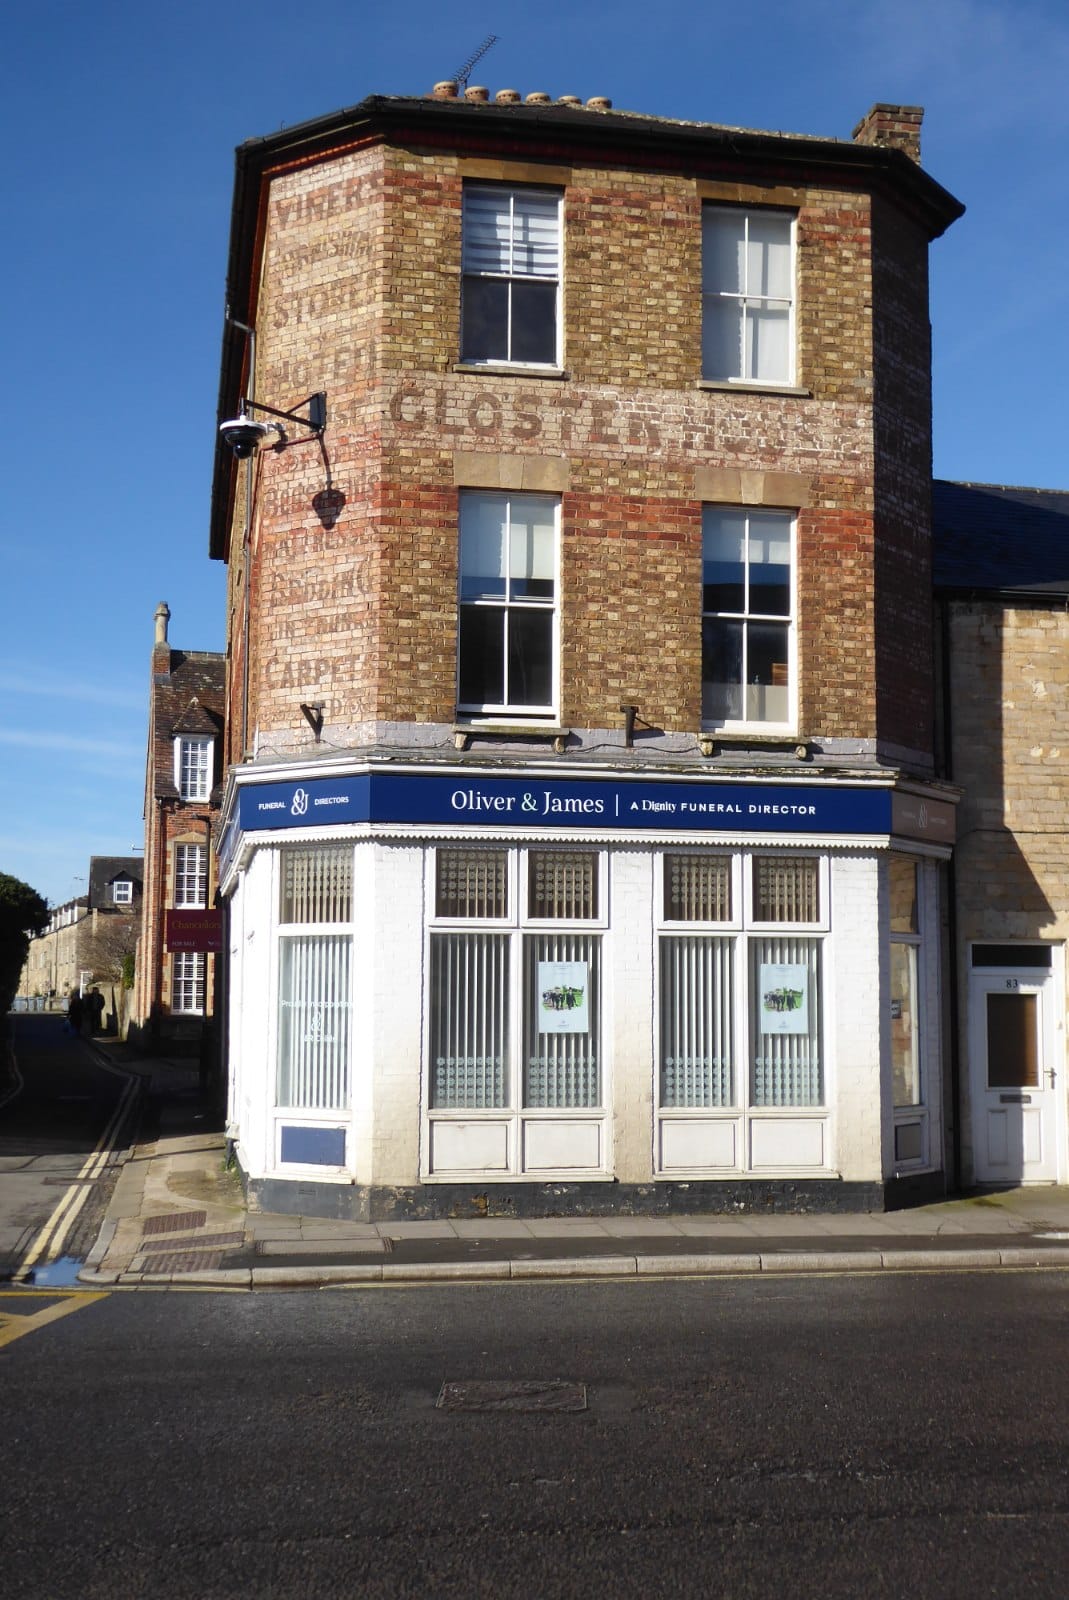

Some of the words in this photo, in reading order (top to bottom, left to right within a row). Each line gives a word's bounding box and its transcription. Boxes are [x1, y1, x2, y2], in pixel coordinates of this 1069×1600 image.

[258, 801, 286, 810] FUNERAL
[314, 796, 349, 806] DIRECTORS
[451, 790, 515, 811] Oliver
[521, 792, 538, 812] &
[542, 791, 604, 816] James
[630, 801, 639, 810] A
[642, 799, 677, 813] Dignity
[681, 802, 742, 813] FUNERAL
[749, 804, 816, 815] DIRECTOR
[1006, 979, 1018, 988] 83
